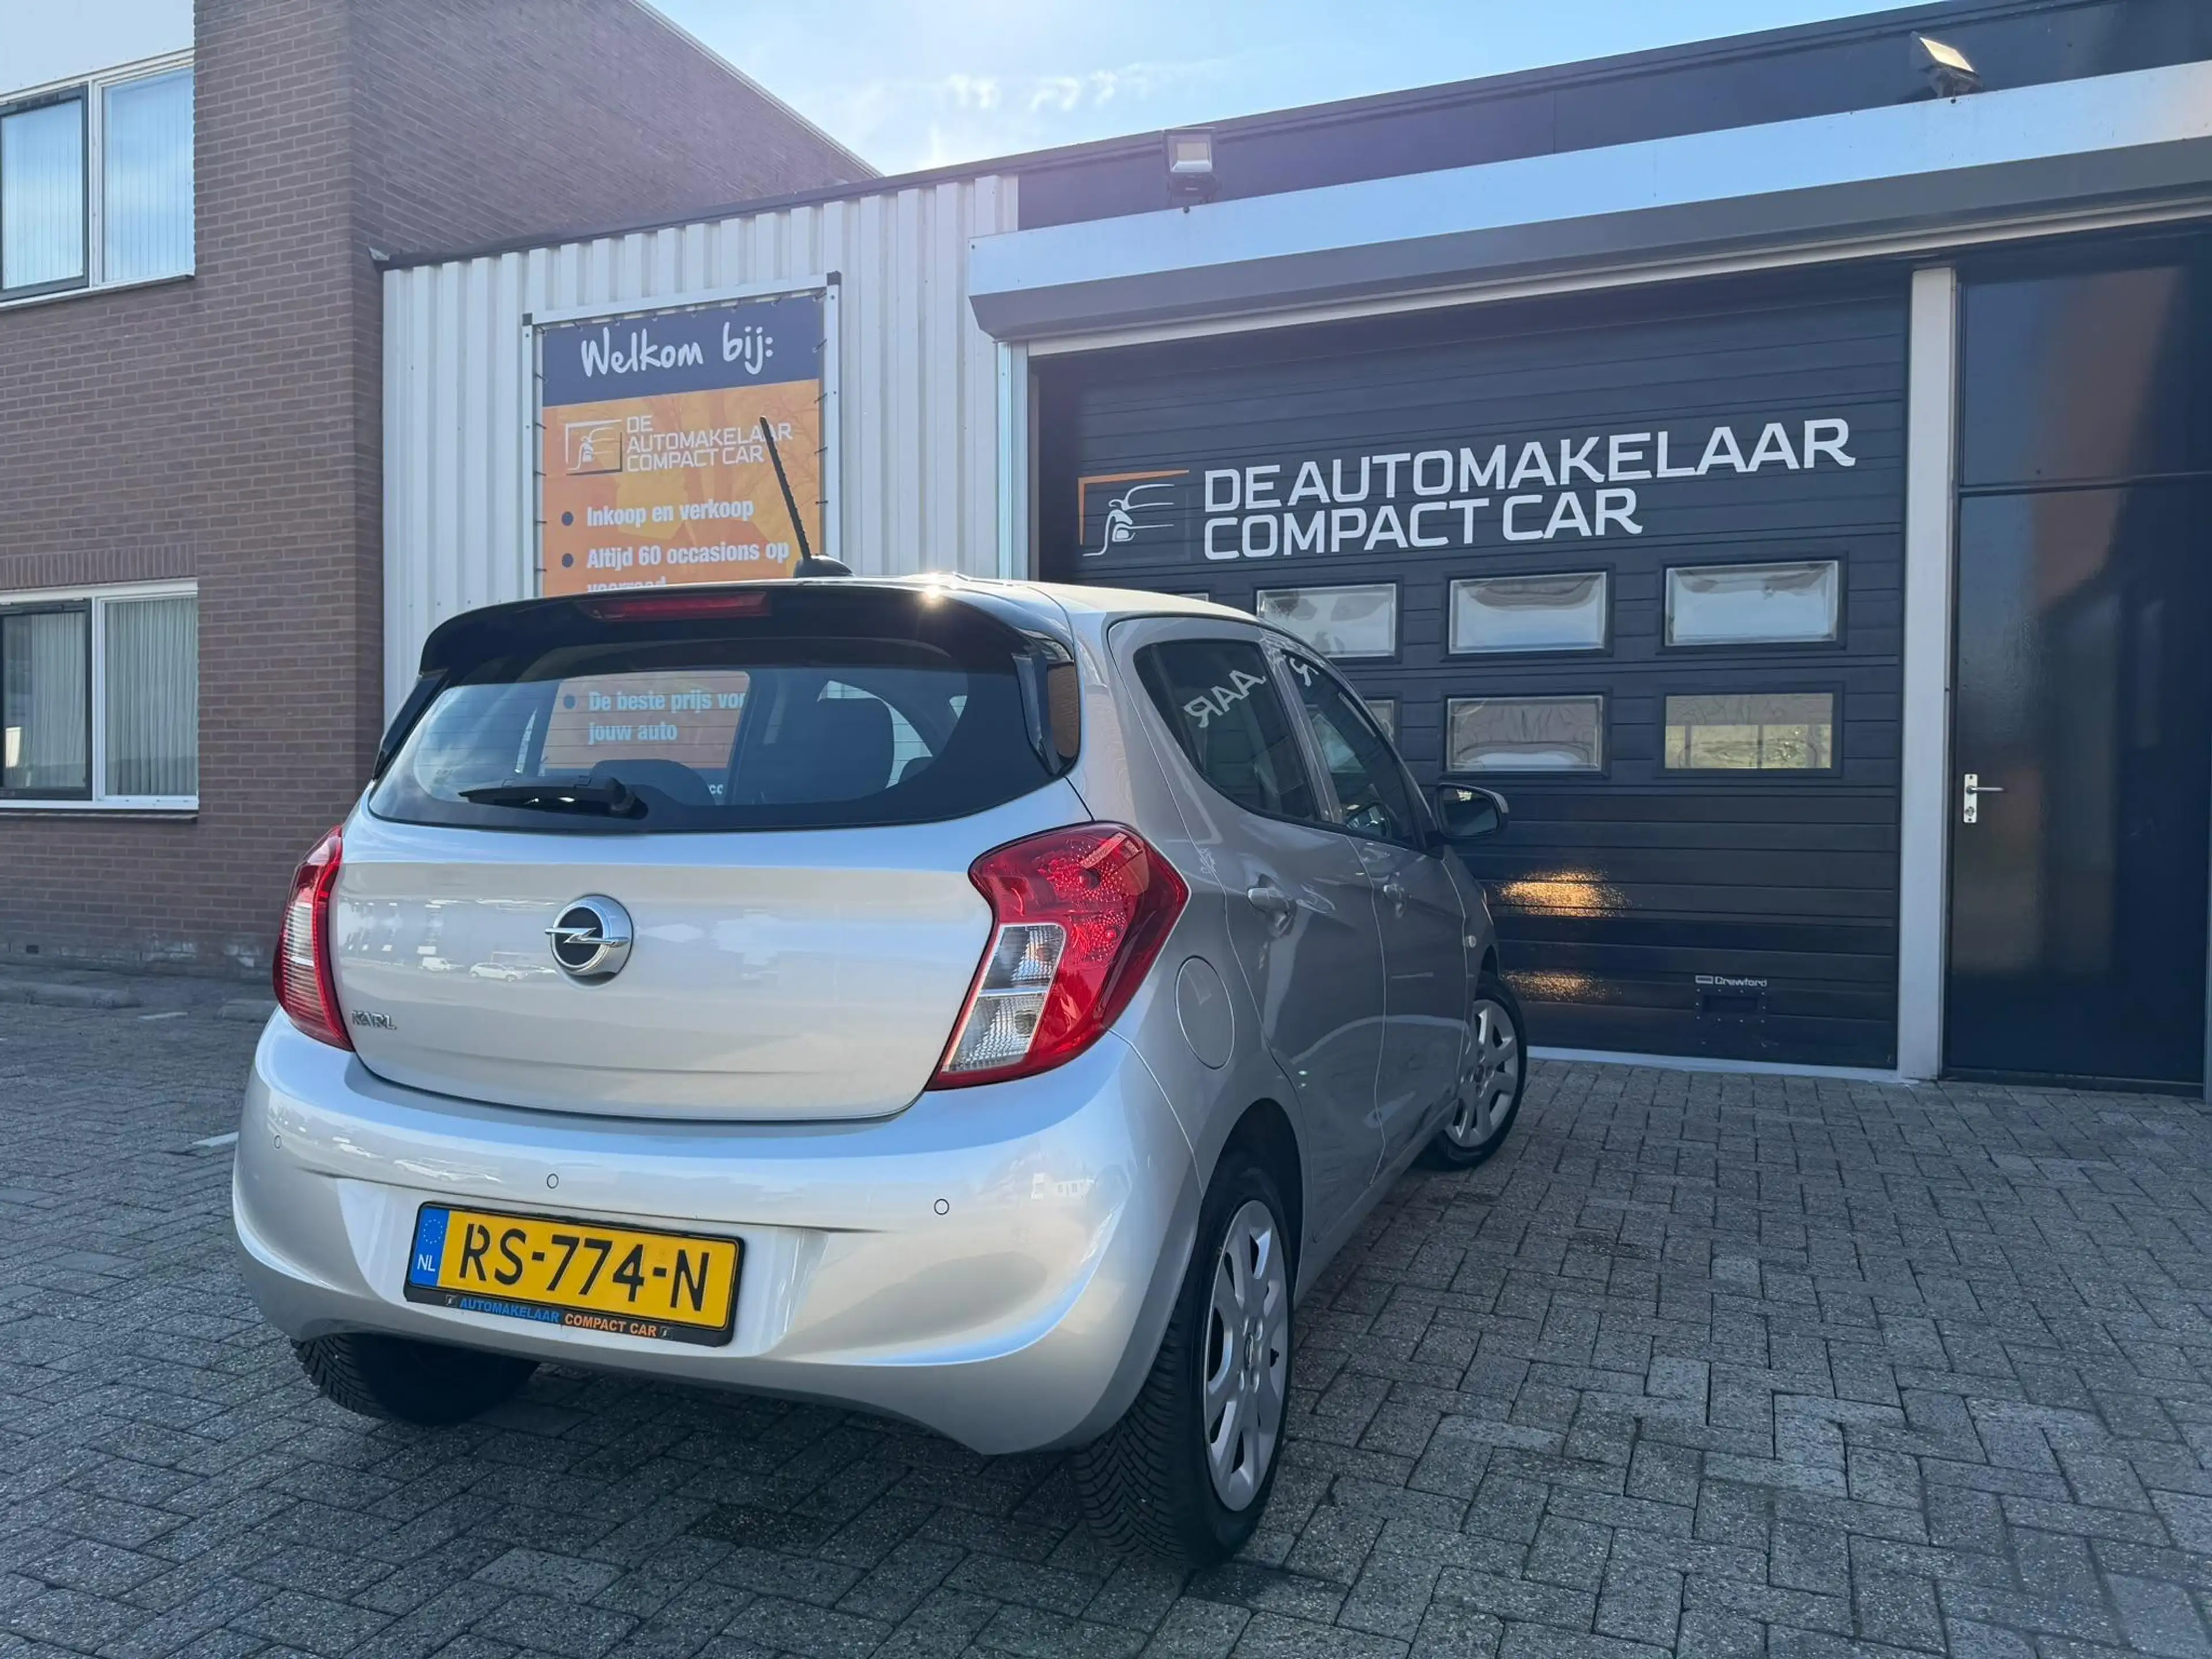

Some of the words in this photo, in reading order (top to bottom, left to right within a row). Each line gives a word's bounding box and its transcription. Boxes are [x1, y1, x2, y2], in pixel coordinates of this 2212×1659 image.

[581, 327, 703, 377] Welkom
[723, 321, 774, 374] bij:
[626, 415, 653, 433] DE
[627, 448, 719, 472] COMPACT
[722, 444, 765, 465] CAR
[1203, 464, 1282, 513] DE
[1287, 418, 1856, 507] AUTOMAKELAAR
[587, 506, 646, 528] Inkoop
[652, 505, 674, 523] en
[679, 499, 755, 520] verkoop
[1203, 498, 1489, 560] COMPACT
[1502, 487, 1643, 541] CAR
[586, 547, 633, 571] Altijd
[638, 546, 661, 566] 60
[666, 541, 760, 564] occasions
[766, 541, 790, 564] op
[588, 691, 611, 711] De
[617, 691, 666, 710] beste
[671, 689, 712, 713] prijs
[588, 722, 632, 745] jouw
[638, 721, 677, 741] auto
[417, 1253, 435, 1272] NL
[459, 1223, 710, 1312] RS-774-N
[460, 1298, 559, 1323] AUTOMAKELAAR
[565, 1313, 626, 1334] COMPACT
[630, 1323, 657, 1338] CAR
